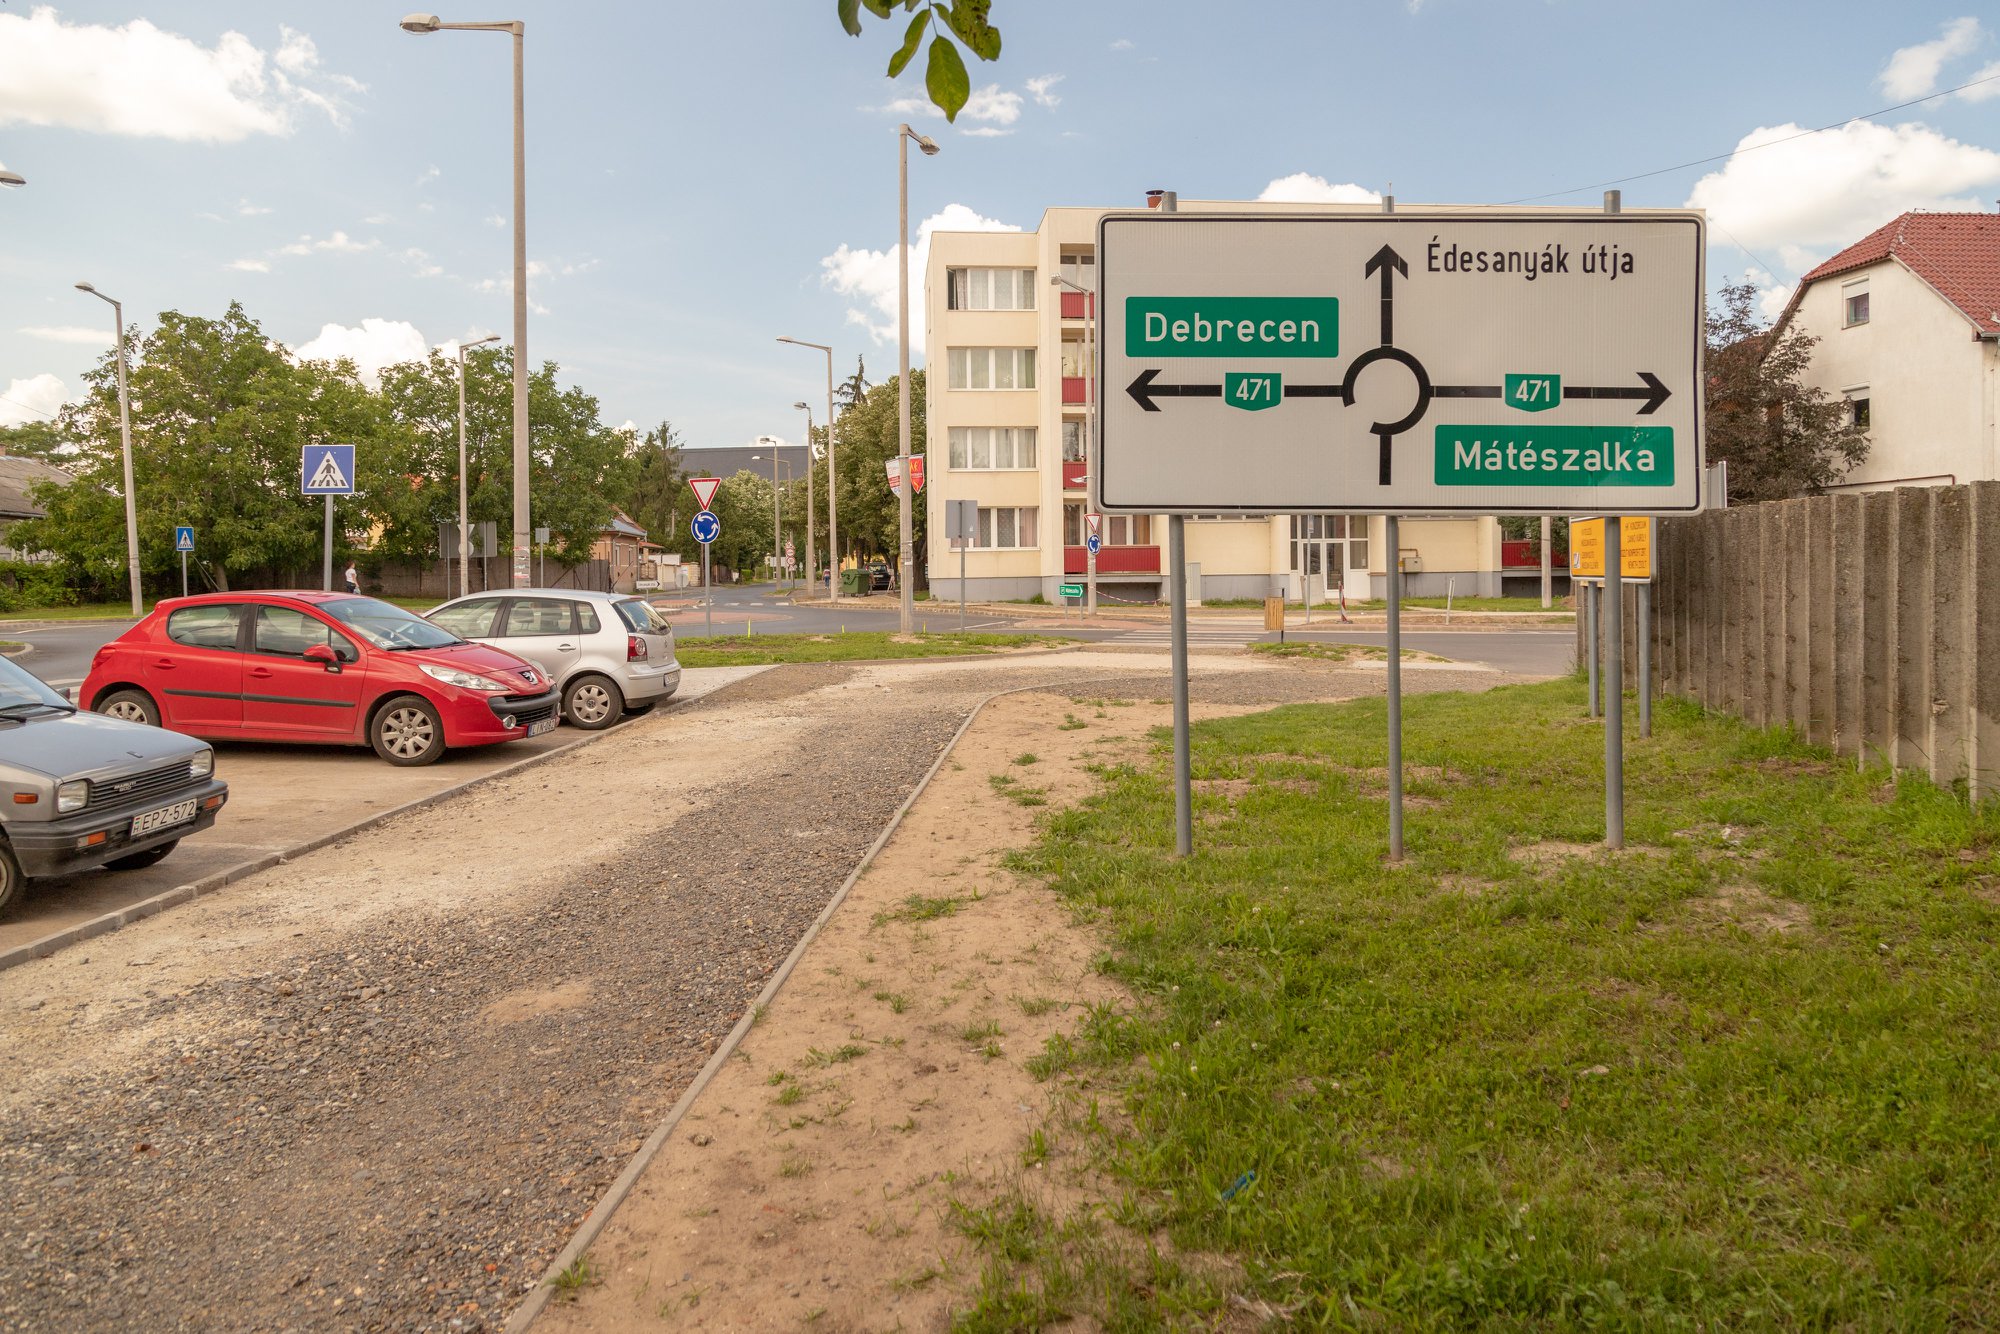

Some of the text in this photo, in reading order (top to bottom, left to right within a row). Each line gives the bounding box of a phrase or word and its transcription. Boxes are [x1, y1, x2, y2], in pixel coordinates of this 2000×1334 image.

[1427, 235, 1634, 281] Édesanyák útja
[1145, 312, 1320, 342] Debrecen
[1236, 378, 1271, 401] 471
[1515, 379, 1550, 402] 471
[1454, 440, 1655, 472] Mátészalka
[142, 801, 195, 830] EPZ-572
